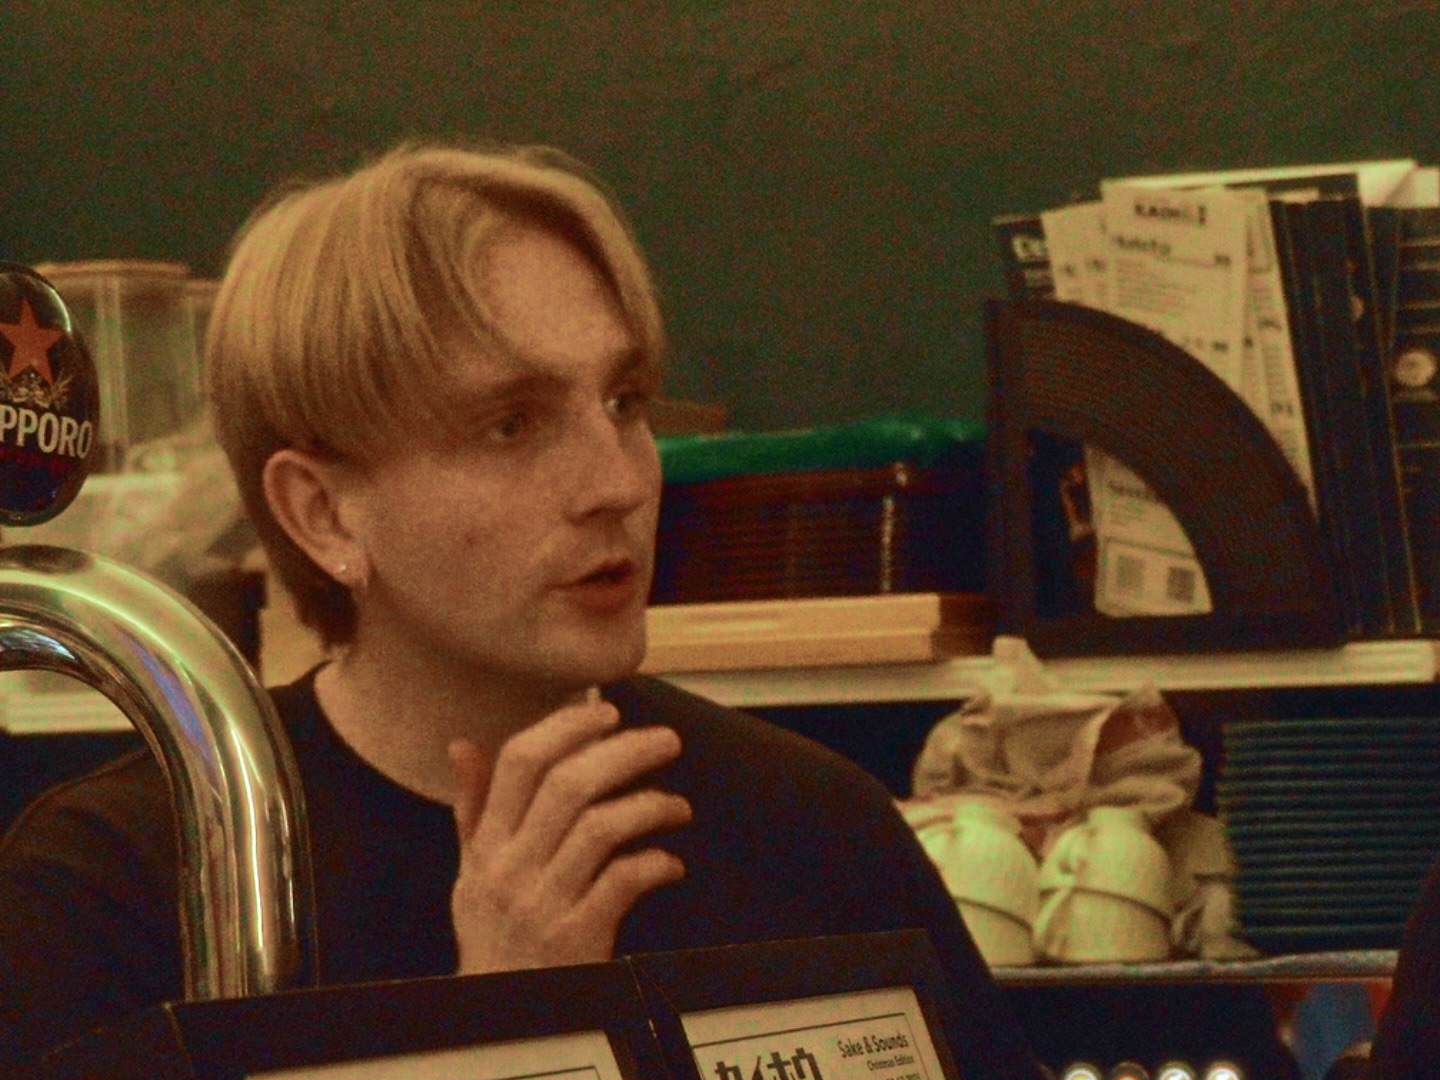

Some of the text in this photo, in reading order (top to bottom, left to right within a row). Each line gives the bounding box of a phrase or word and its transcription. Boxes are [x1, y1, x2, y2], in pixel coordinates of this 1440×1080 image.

[837, 1034, 909, 1059] Sake & Sounds
